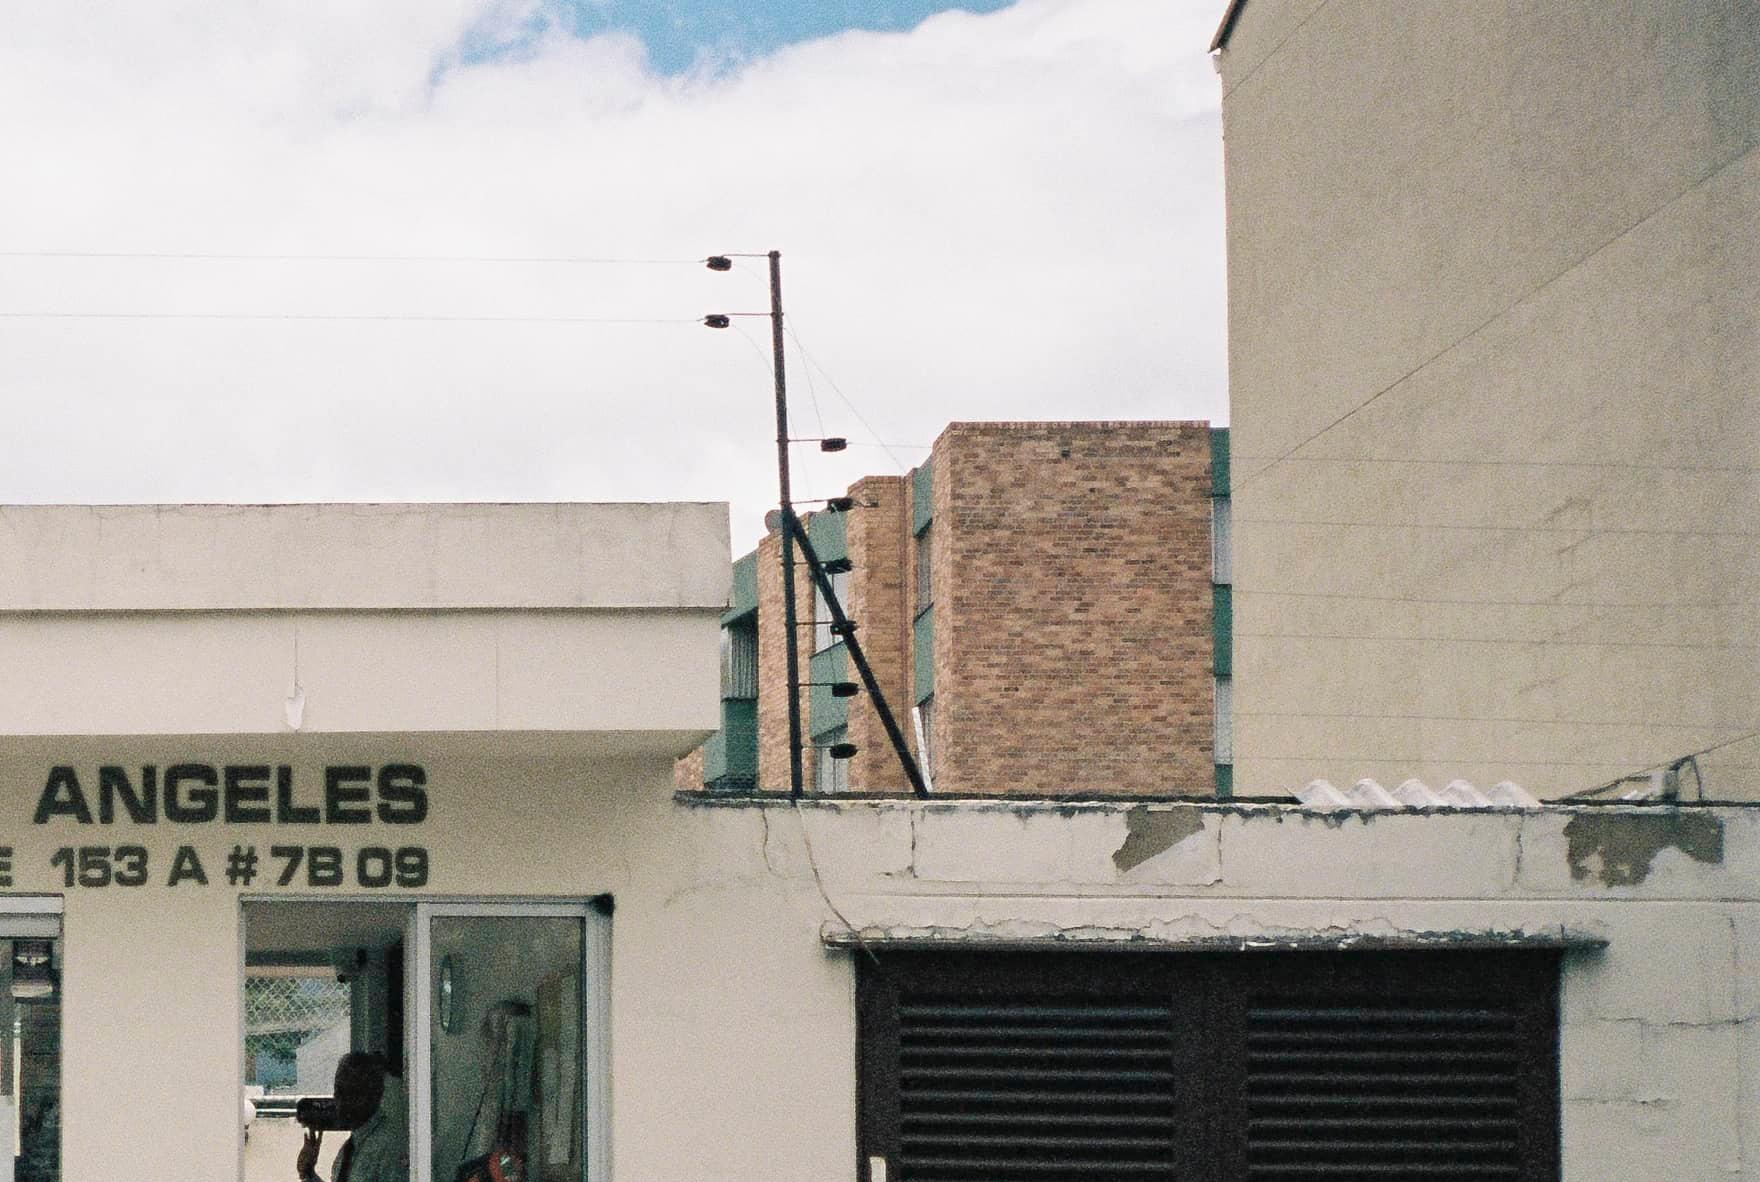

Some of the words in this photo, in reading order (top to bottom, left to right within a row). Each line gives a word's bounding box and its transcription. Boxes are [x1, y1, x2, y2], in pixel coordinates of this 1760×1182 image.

[32, 763, 429, 826] ANGELES
[50, 845, 150, 889] 153
[167, 846, 209, 888] A
[356, 846, 429, 889] 09
